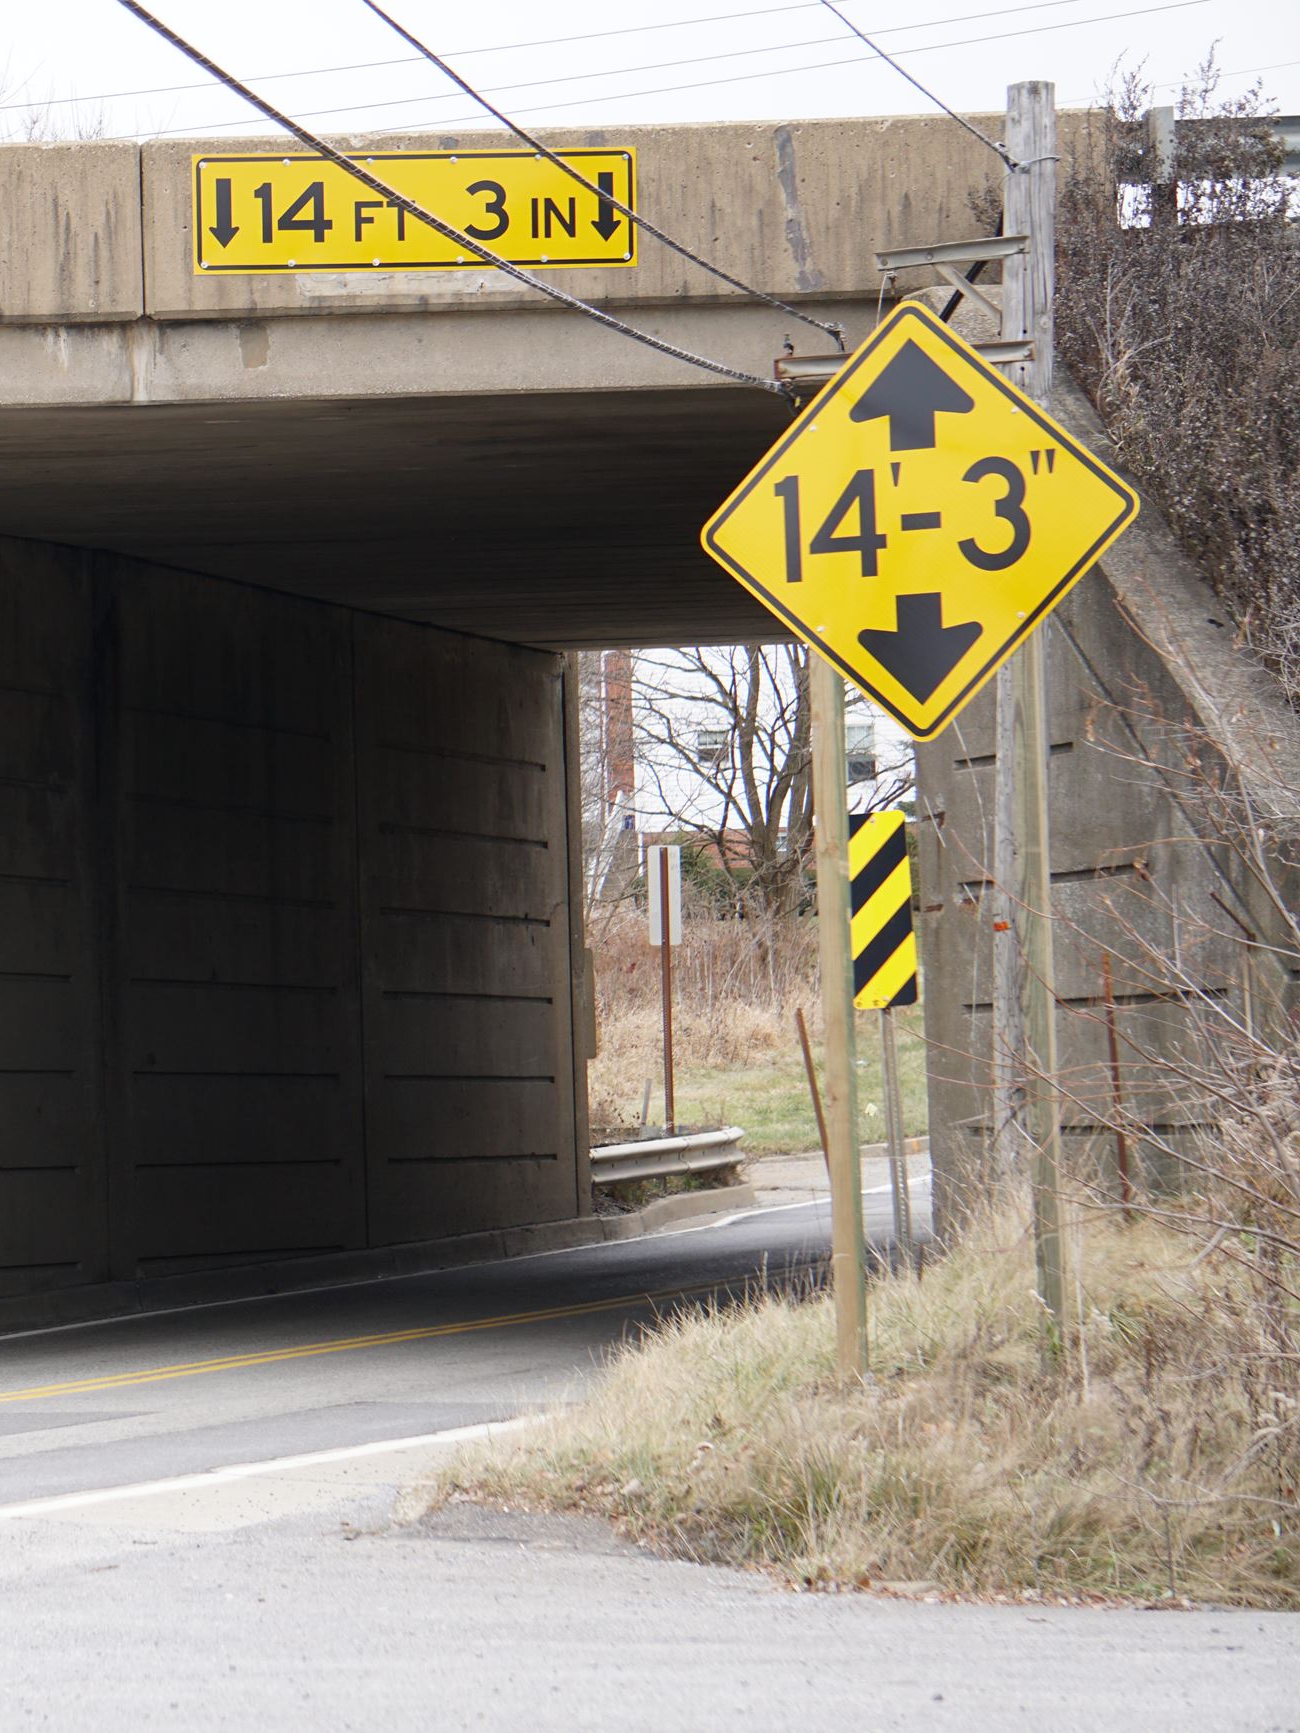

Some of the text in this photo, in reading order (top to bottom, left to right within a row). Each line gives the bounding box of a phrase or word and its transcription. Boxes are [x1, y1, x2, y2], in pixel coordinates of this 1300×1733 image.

[254, 180, 576, 243] 14 FT 3 IN
